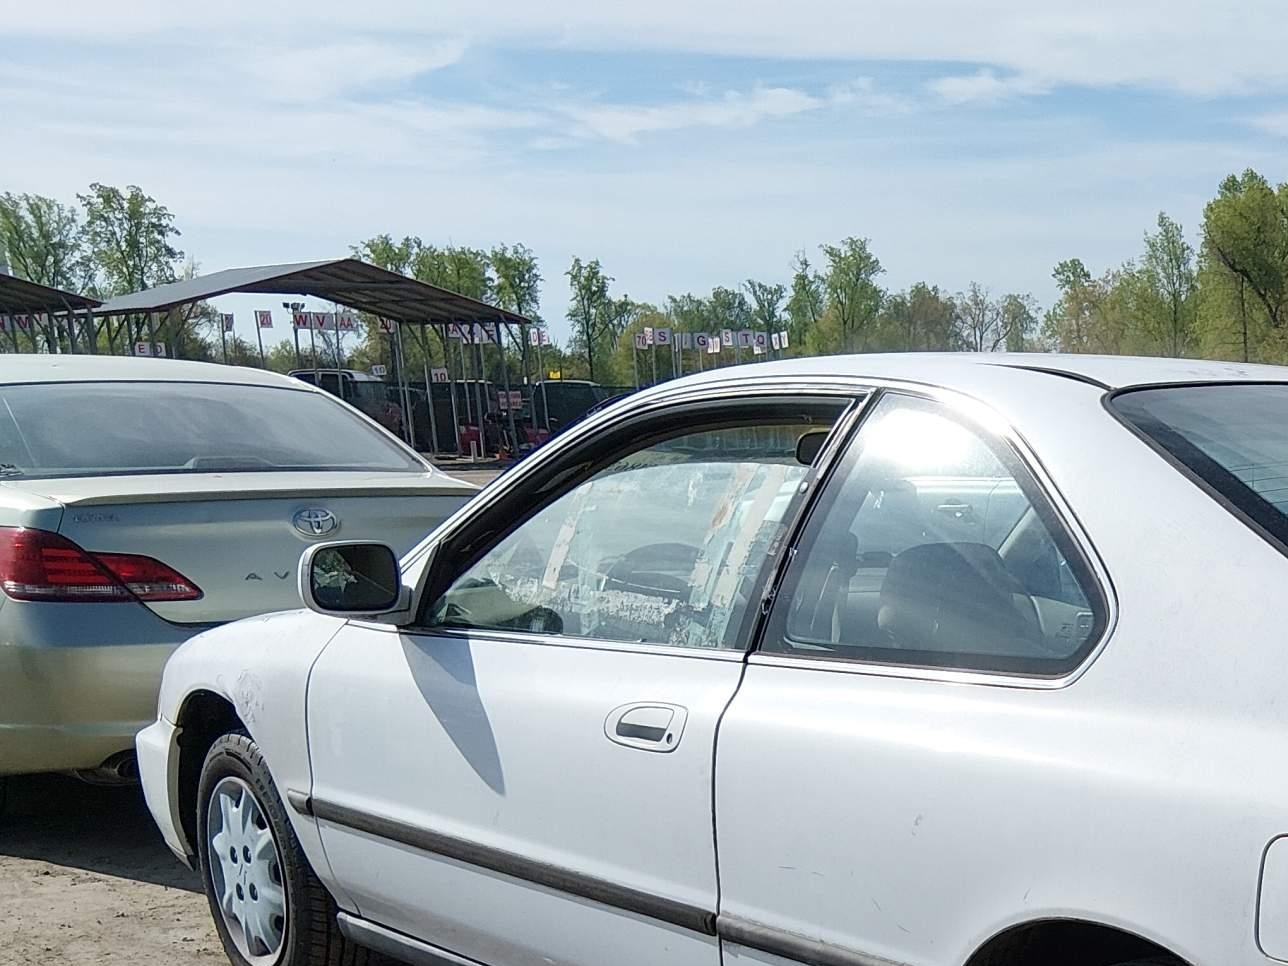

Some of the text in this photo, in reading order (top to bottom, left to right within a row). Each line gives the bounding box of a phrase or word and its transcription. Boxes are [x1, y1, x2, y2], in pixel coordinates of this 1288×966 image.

[294, 315, 307, 327] W
[315, 315, 326, 327] V
[339, 317, 353, 329] AA
[636, 335, 647, 347] 70
[657, 331, 667, 342] S
[696, 335, 706, 346] G
[741, 333, 751, 343] T
[138, 344, 145, 354] E
[433, 372, 447, 382] 10
